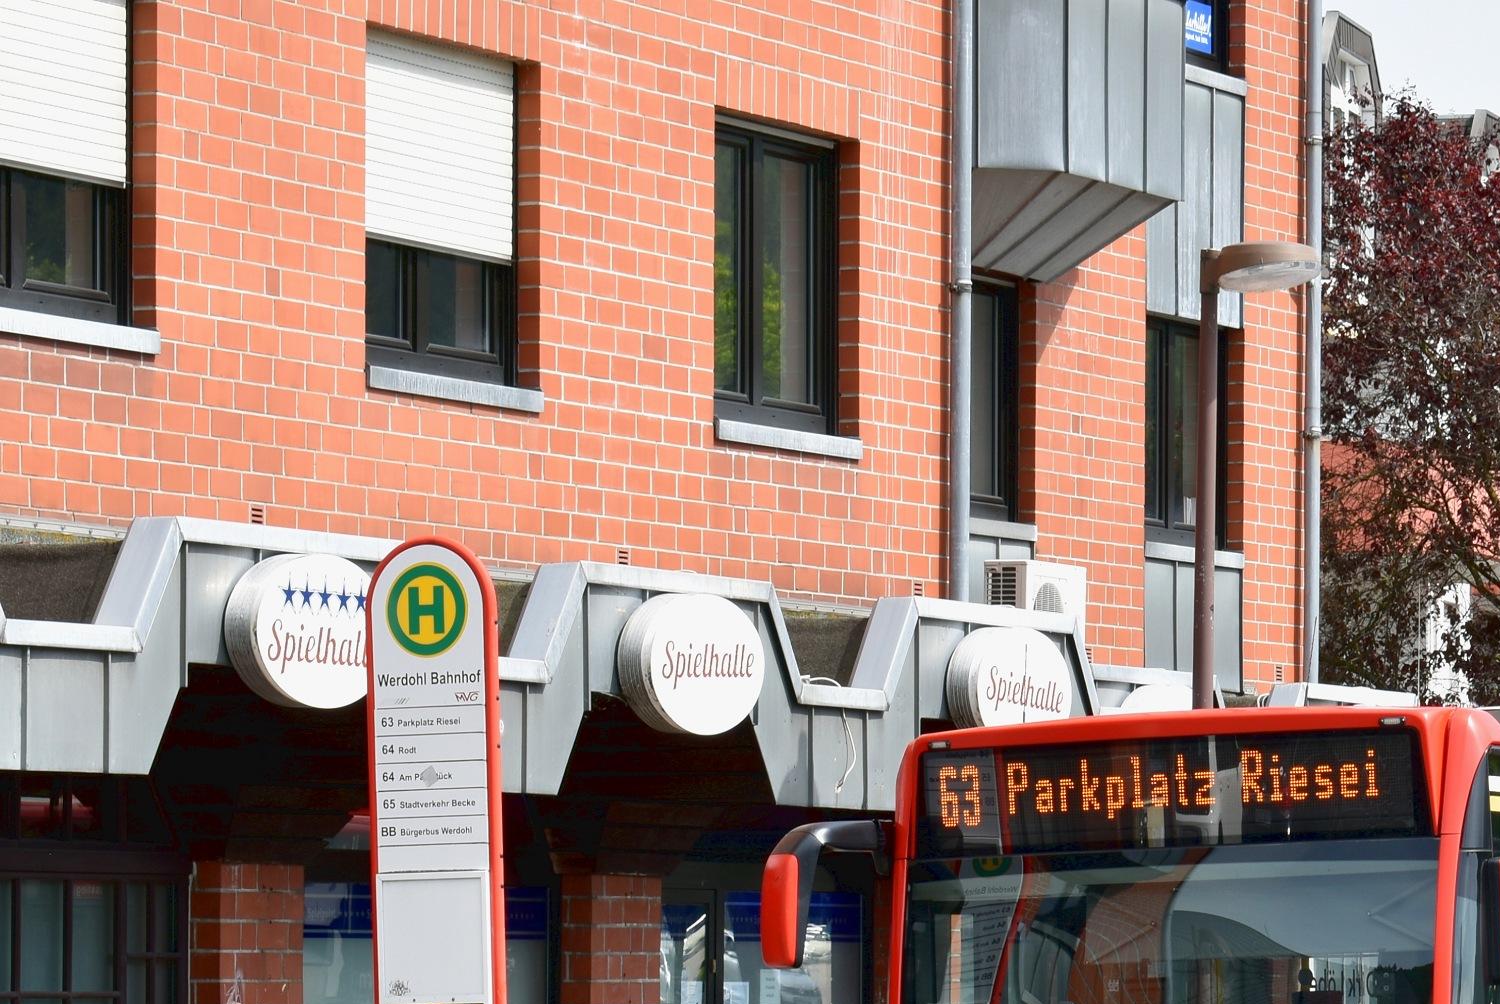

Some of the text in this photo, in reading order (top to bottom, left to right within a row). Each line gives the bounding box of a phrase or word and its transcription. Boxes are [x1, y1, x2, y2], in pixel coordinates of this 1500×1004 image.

[267, 619, 367, 674] Spielhall
[662, 640, 754, 690] Spielhalle
[377, 669, 481, 687] Werdohl Bahnhof
[986, 665, 1063, 713] Spielhalle
[455, 690, 480, 702] MVG
[381, 716, 394, 728] 63
[397, 717, 434, 728] Parkplatz
[382, 744, 416, 755] 64 Rodt
[382, 771, 395, 782] 64
[399, 774, 412, 782] Am
[939, 764, 981, 828] 63
[1006, 753, 1216, 820] Parkplatz
[1240, 749, 1380, 803] Riesei
[383, 798, 476, 810] 65 Stadtverkehr Becke
[381, 826, 472, 837] BB Bürgerbus Werdohl
